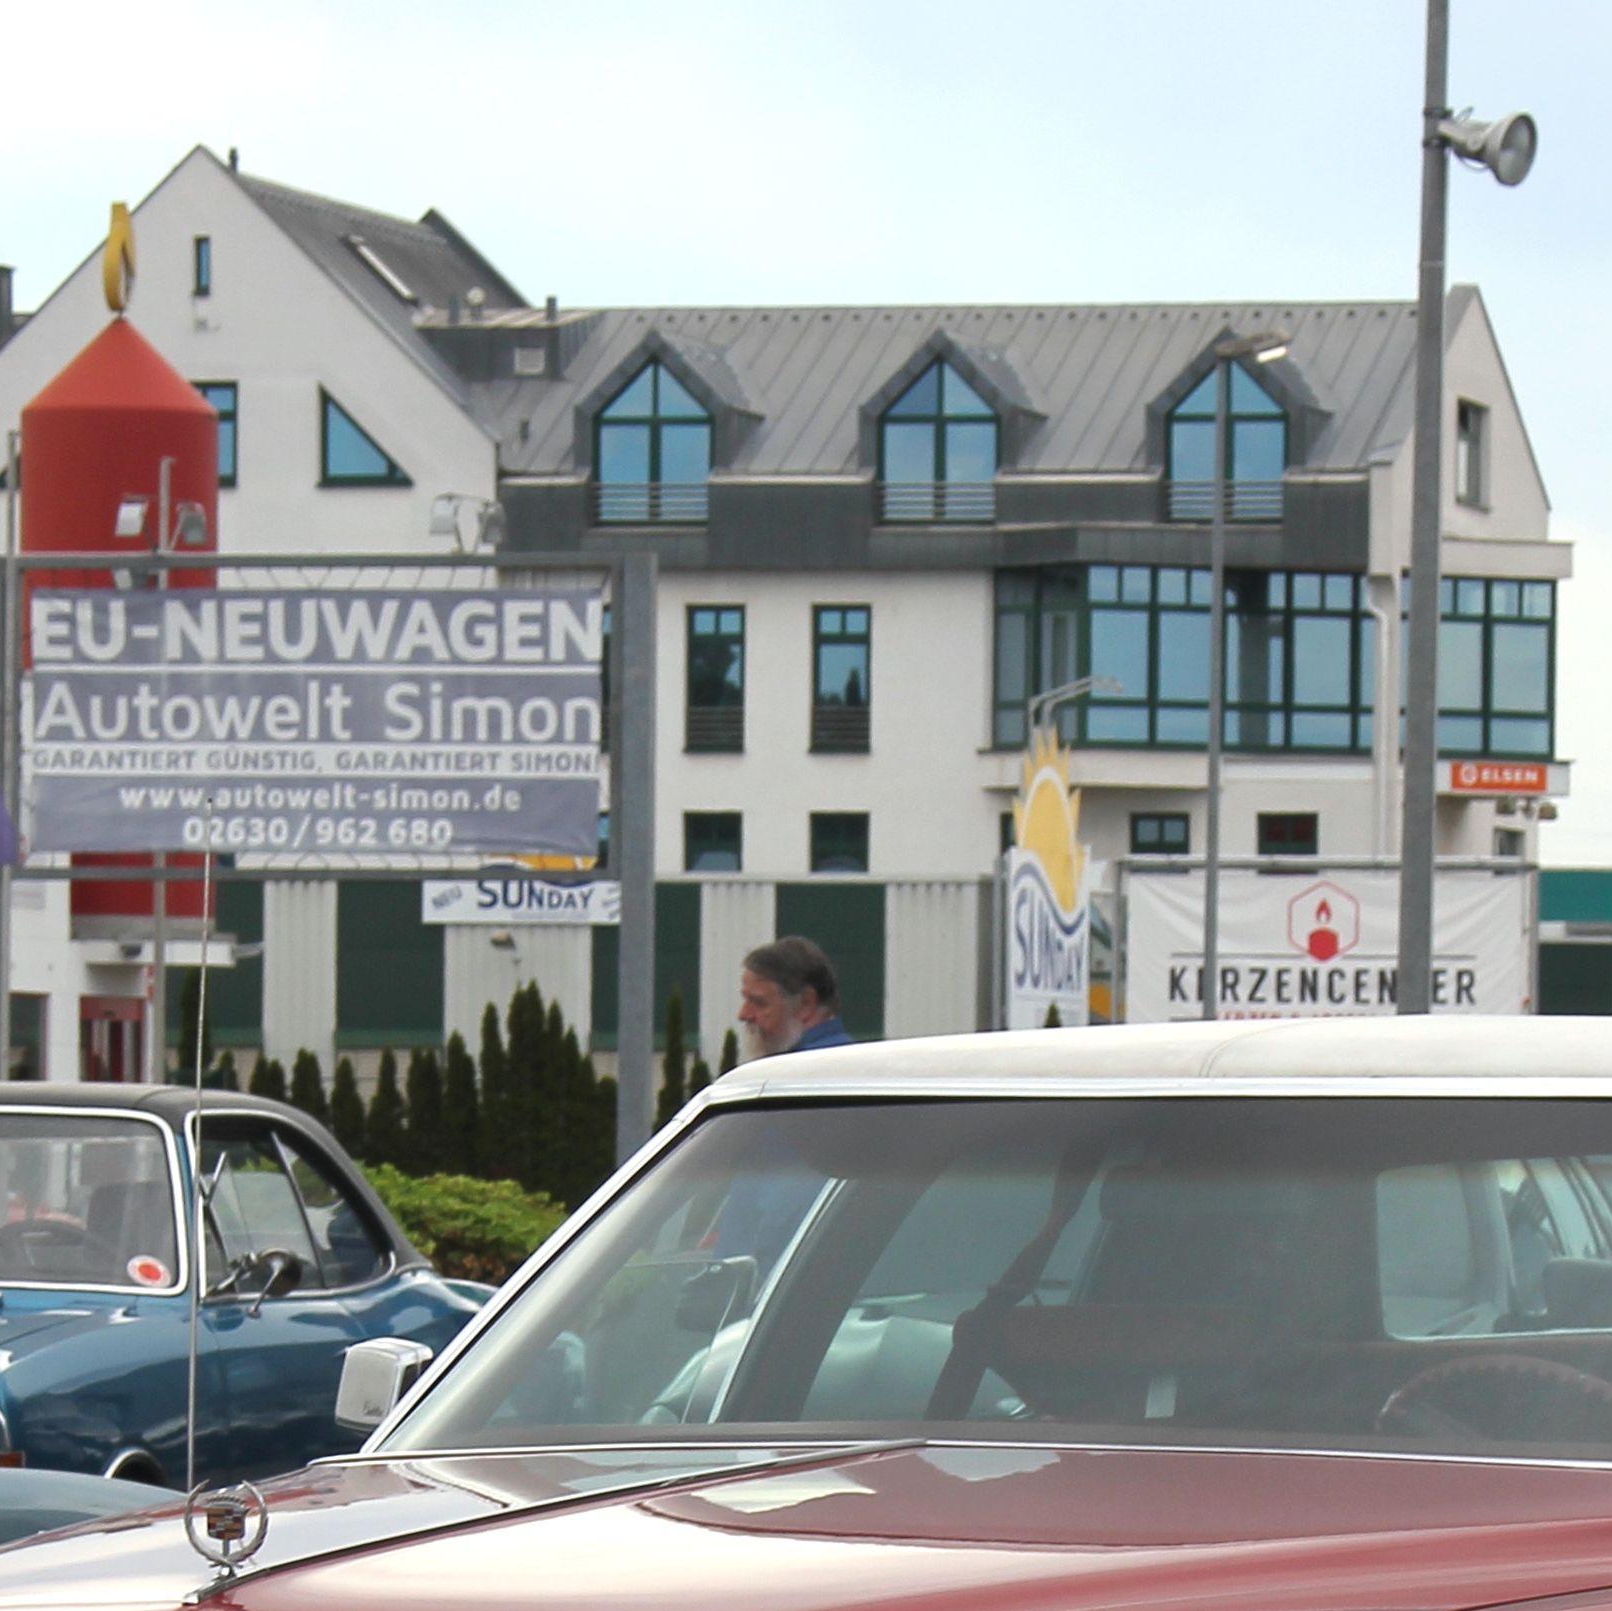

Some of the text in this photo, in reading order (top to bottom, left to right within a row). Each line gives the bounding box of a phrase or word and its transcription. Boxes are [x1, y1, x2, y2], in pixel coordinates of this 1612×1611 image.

[32, 599, 602, 661] EU-NEUWAGEN
[34, 681, 599, 742] Autowelt Simon
[34, 751, 196, 770] GARANTIERT
[207, 745, 322, 774] GÜNSTIG,
[336, 753, 500, 772] GARANTIERT
[387, 818, 454, 847] 680
[1169, 966, 1476, 1005] KRZENCENER
